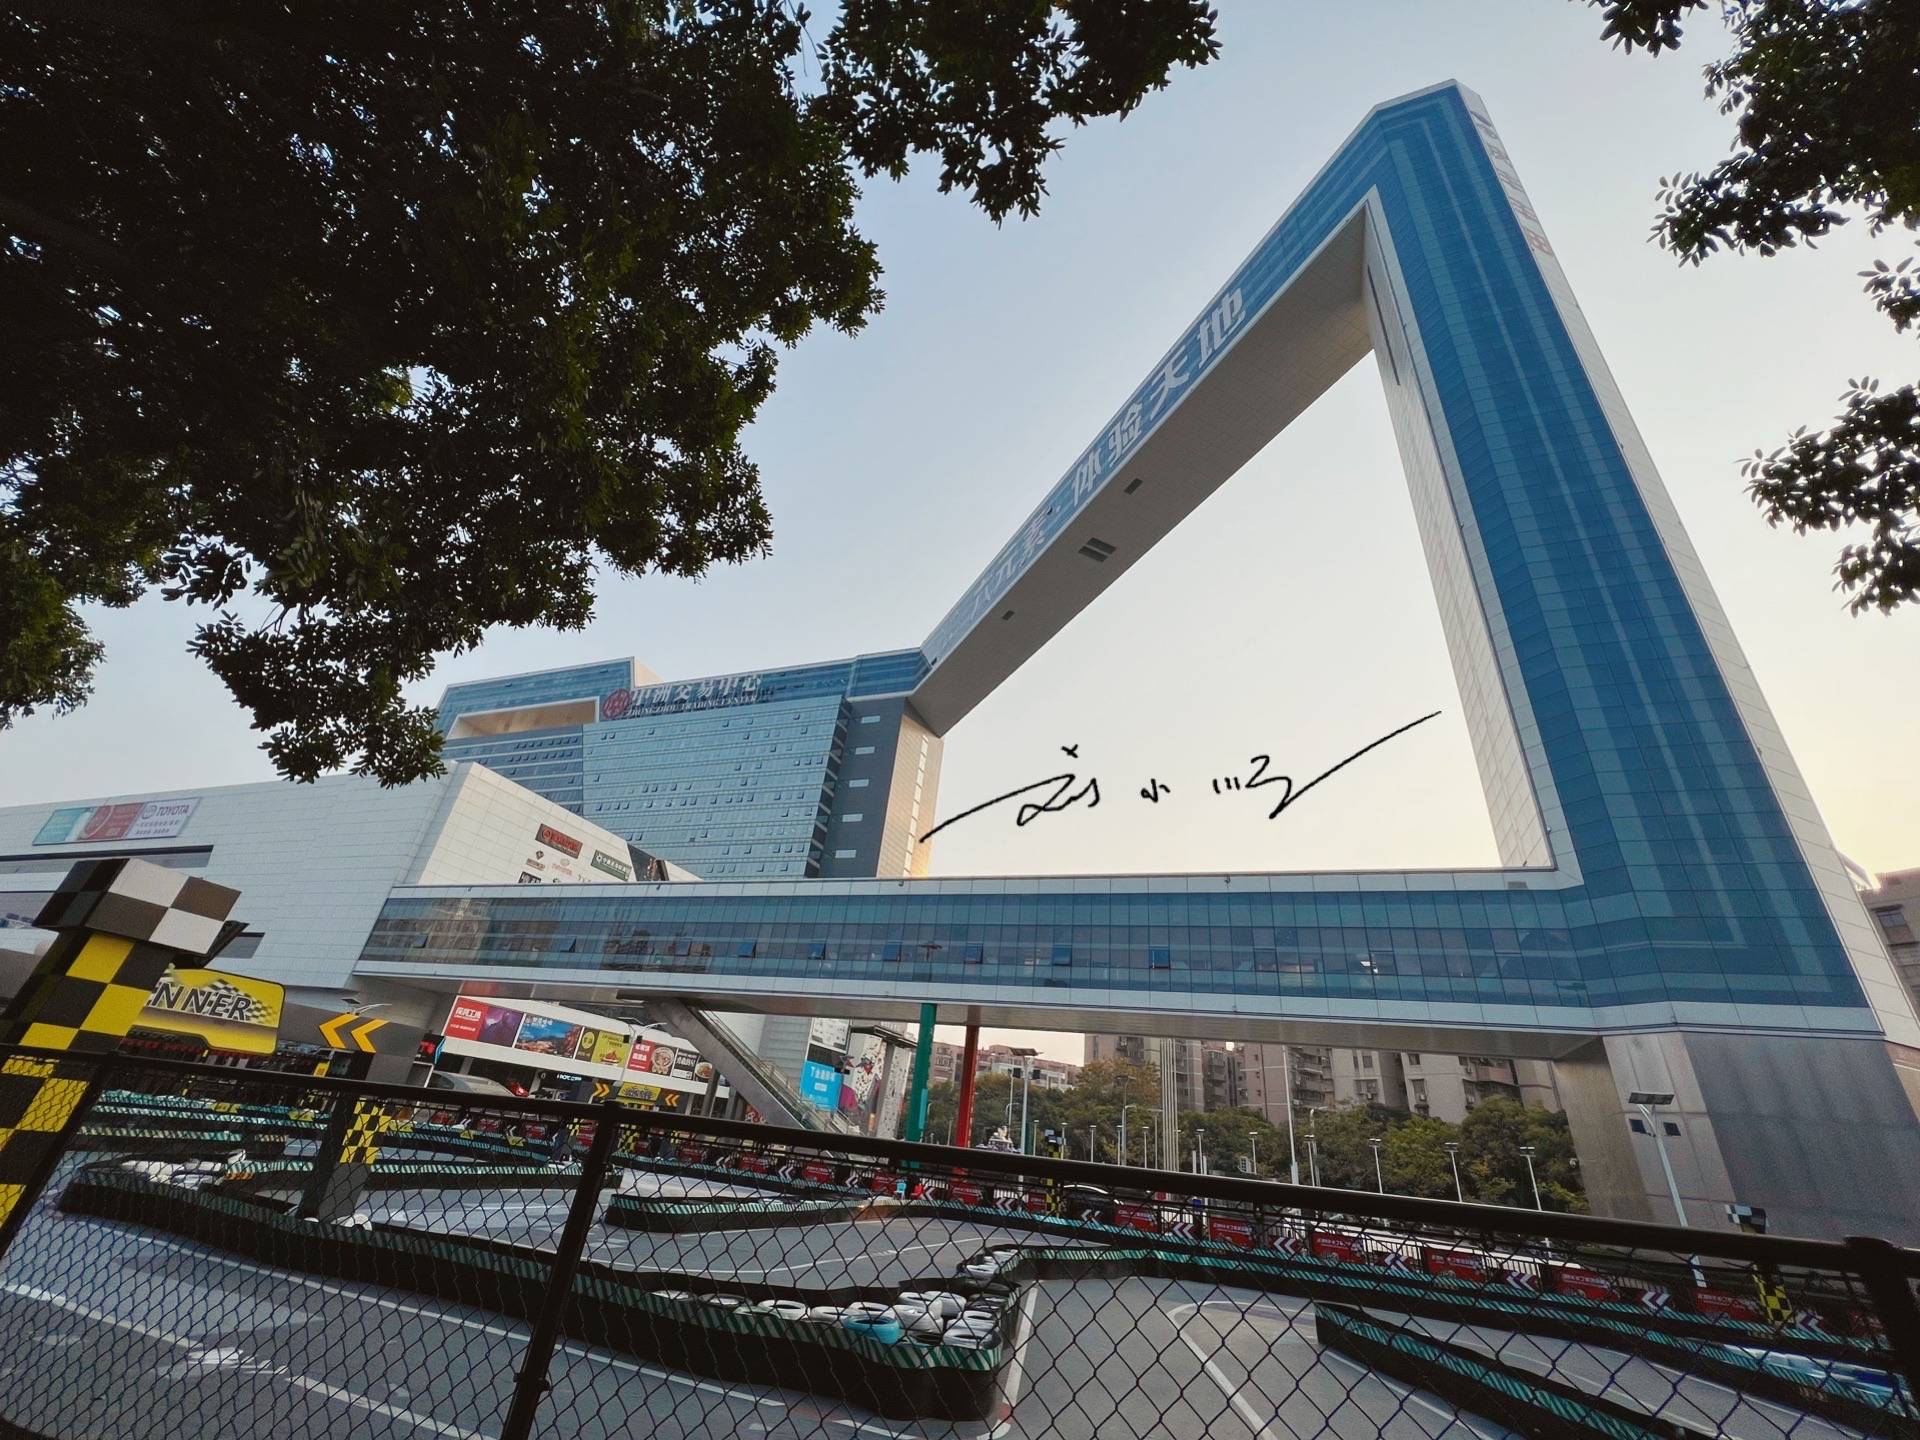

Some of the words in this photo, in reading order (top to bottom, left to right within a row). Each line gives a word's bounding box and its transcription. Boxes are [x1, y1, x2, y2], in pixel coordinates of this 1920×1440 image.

[632, 675, 761, 706] 中洲交易中心
[156, 804, 190, 817] TOYOTA
